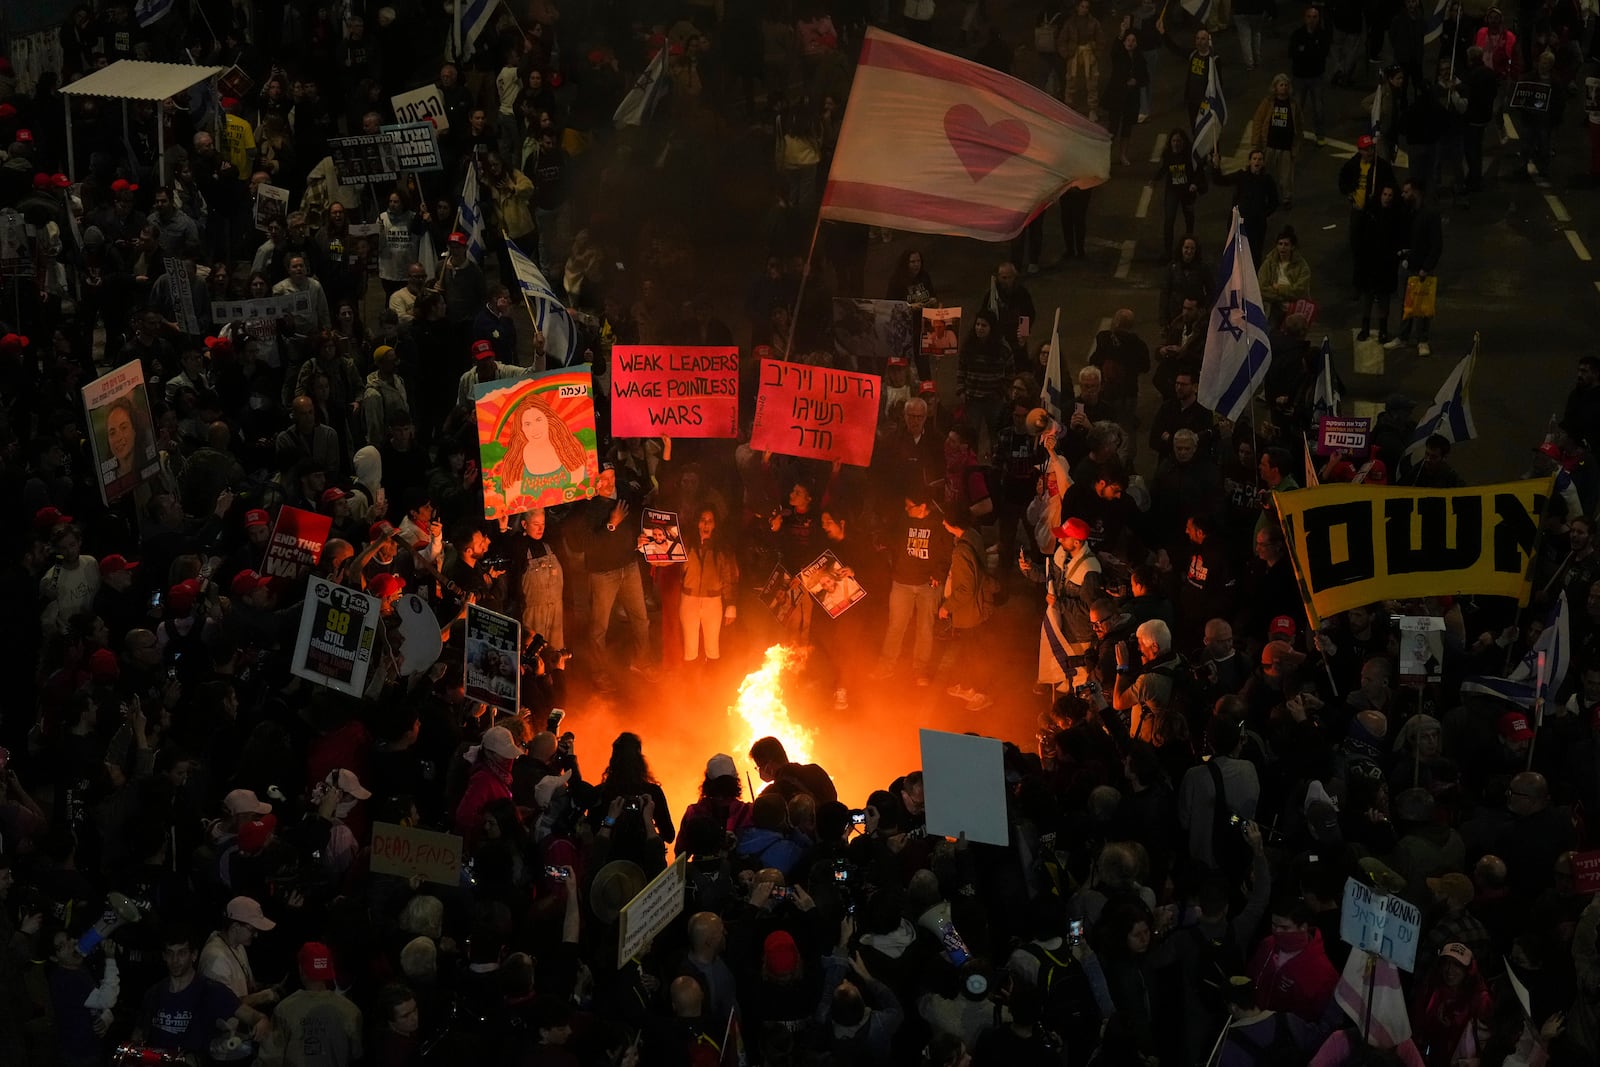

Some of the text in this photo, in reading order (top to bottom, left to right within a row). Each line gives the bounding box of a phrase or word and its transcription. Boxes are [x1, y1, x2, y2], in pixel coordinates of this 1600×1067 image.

[397, 96, 442, 124] הביתה
[619, 353, 738, 372] WEAK LEADERS
[561, 385, 587, 396] נעמה
[614, 377, 737, 398] WAGE POINTLESS
[764, 364, 874, 400] גדעון ויריב
[648, 405, 703, 426] WARS
[792, 396, 843, 426] תשיגו
[791, 425, 833, 450] חדר
[1327, 434, 1364, 446] עכשיו
[274, 532, 322, 552] END THIS
[349, 597, 369, 608] FCK
[327, 607, 350, 634] 98
[324, 630, 345, 645] STILL
[309, 636, 356, 661] abandoned
